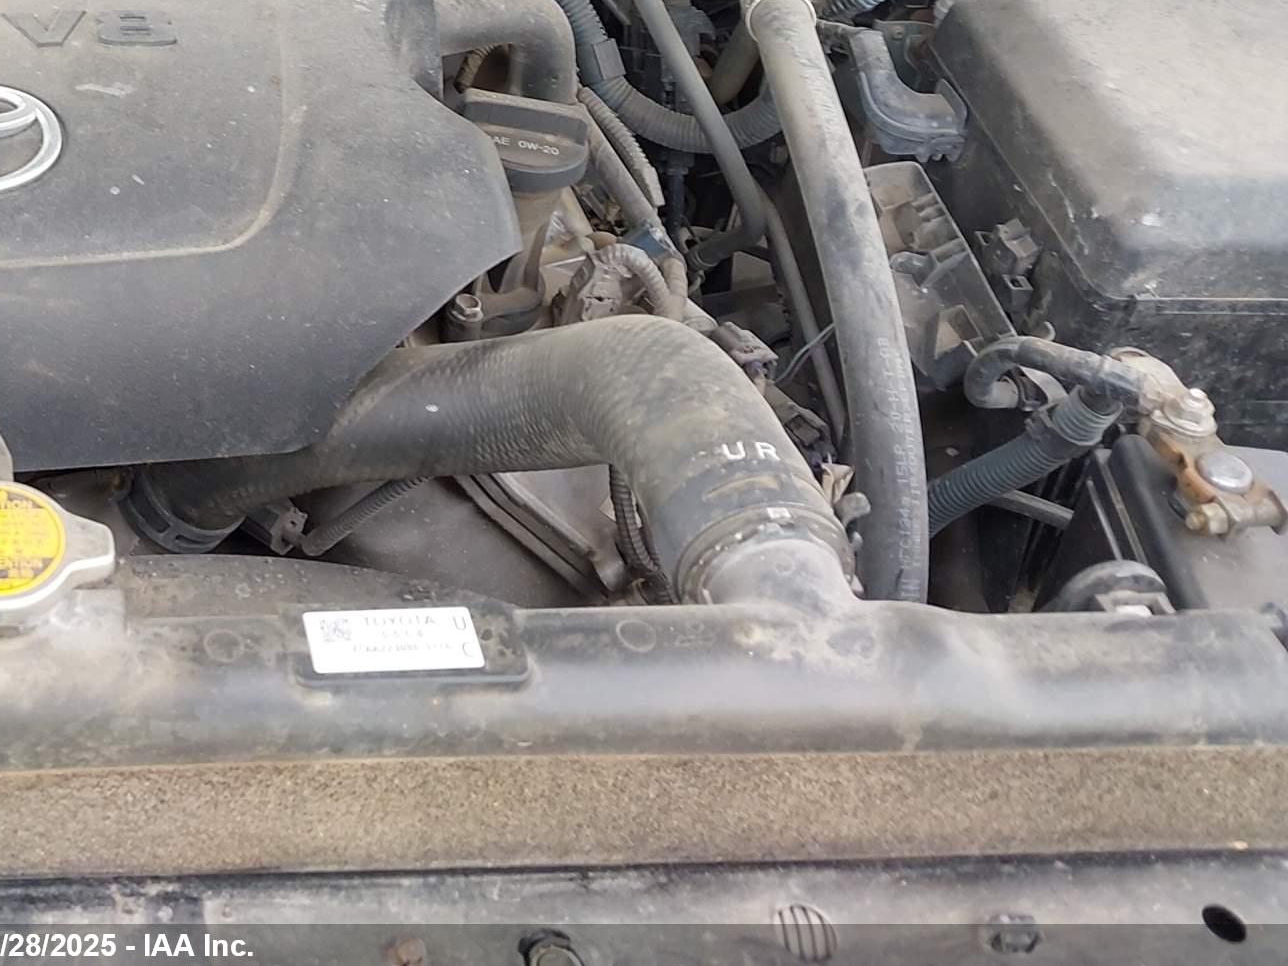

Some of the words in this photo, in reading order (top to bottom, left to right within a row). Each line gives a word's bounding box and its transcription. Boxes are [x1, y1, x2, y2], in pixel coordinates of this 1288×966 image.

[1, 9, 179, 49] V8
[493, 135, 511, 146] AE
[518, 139, 560, 156] 0W-20
[363, 615, 437, 627] TOYOTA
